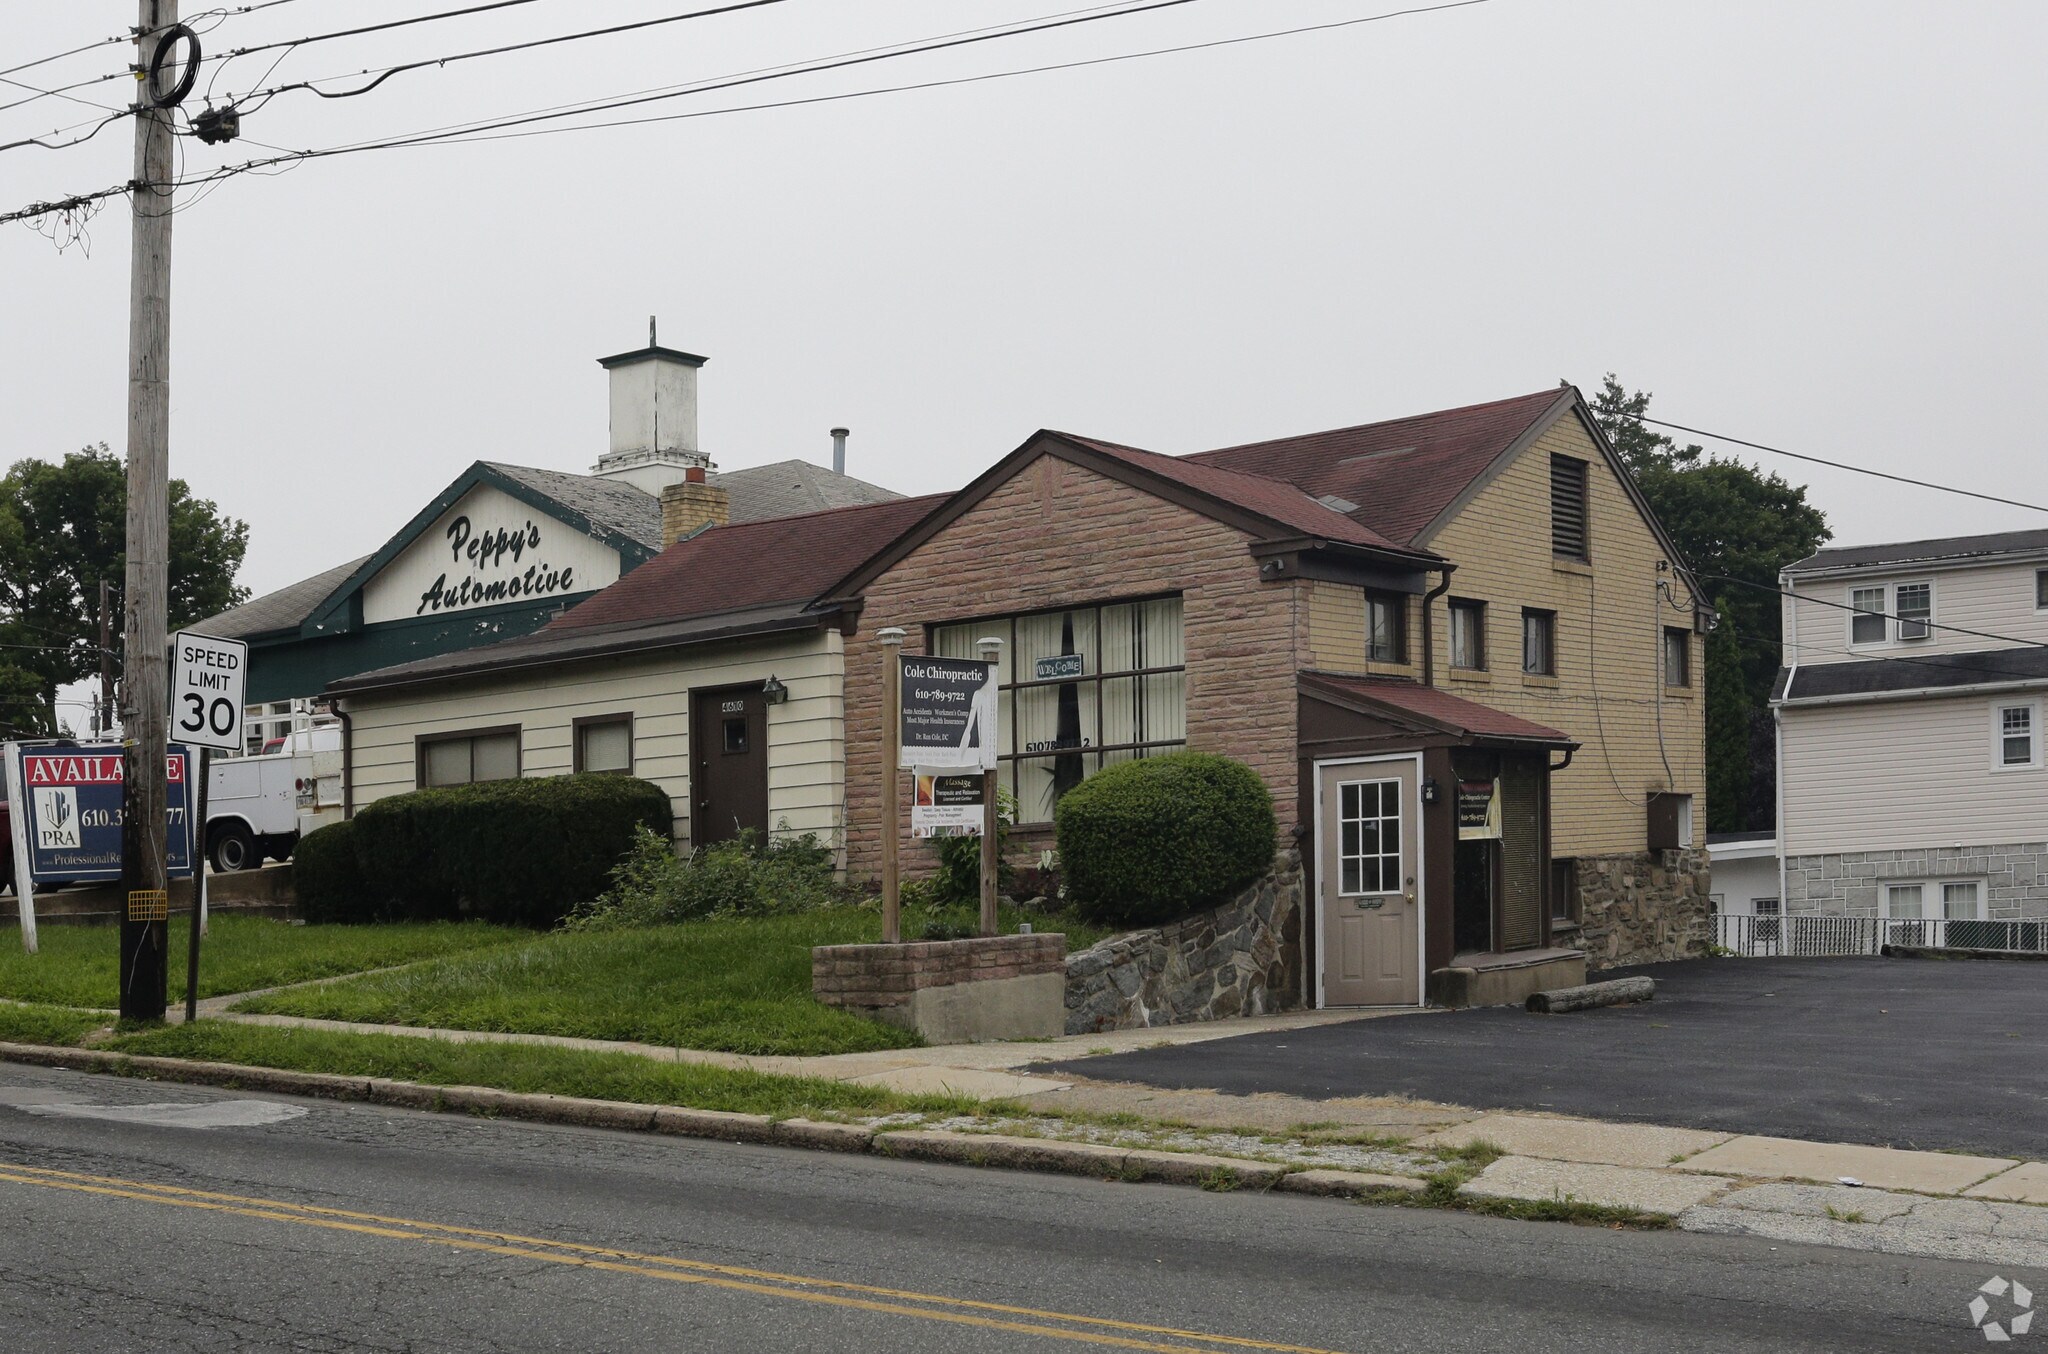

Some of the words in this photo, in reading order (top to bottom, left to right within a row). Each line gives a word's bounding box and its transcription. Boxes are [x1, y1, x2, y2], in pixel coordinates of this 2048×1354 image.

[447, 515, 541, 570] Peppy's
[416, 563, 574, 615] Automotive
[183, 646, 239, 670] SPEED
[1037, 660, 1080, 676] WELCOME
[188, 669, 231, 691] LIMIT
[904, 664, 925, 678] Cole
[926, 665, 983, 683] Chiropractic
[915, 687, 966, 702] 610-789-9722
[179, 692, 235, 737] 30
[31, 757, 180, 782] AVAILAE
[42, 830, 77, 846] PRA
